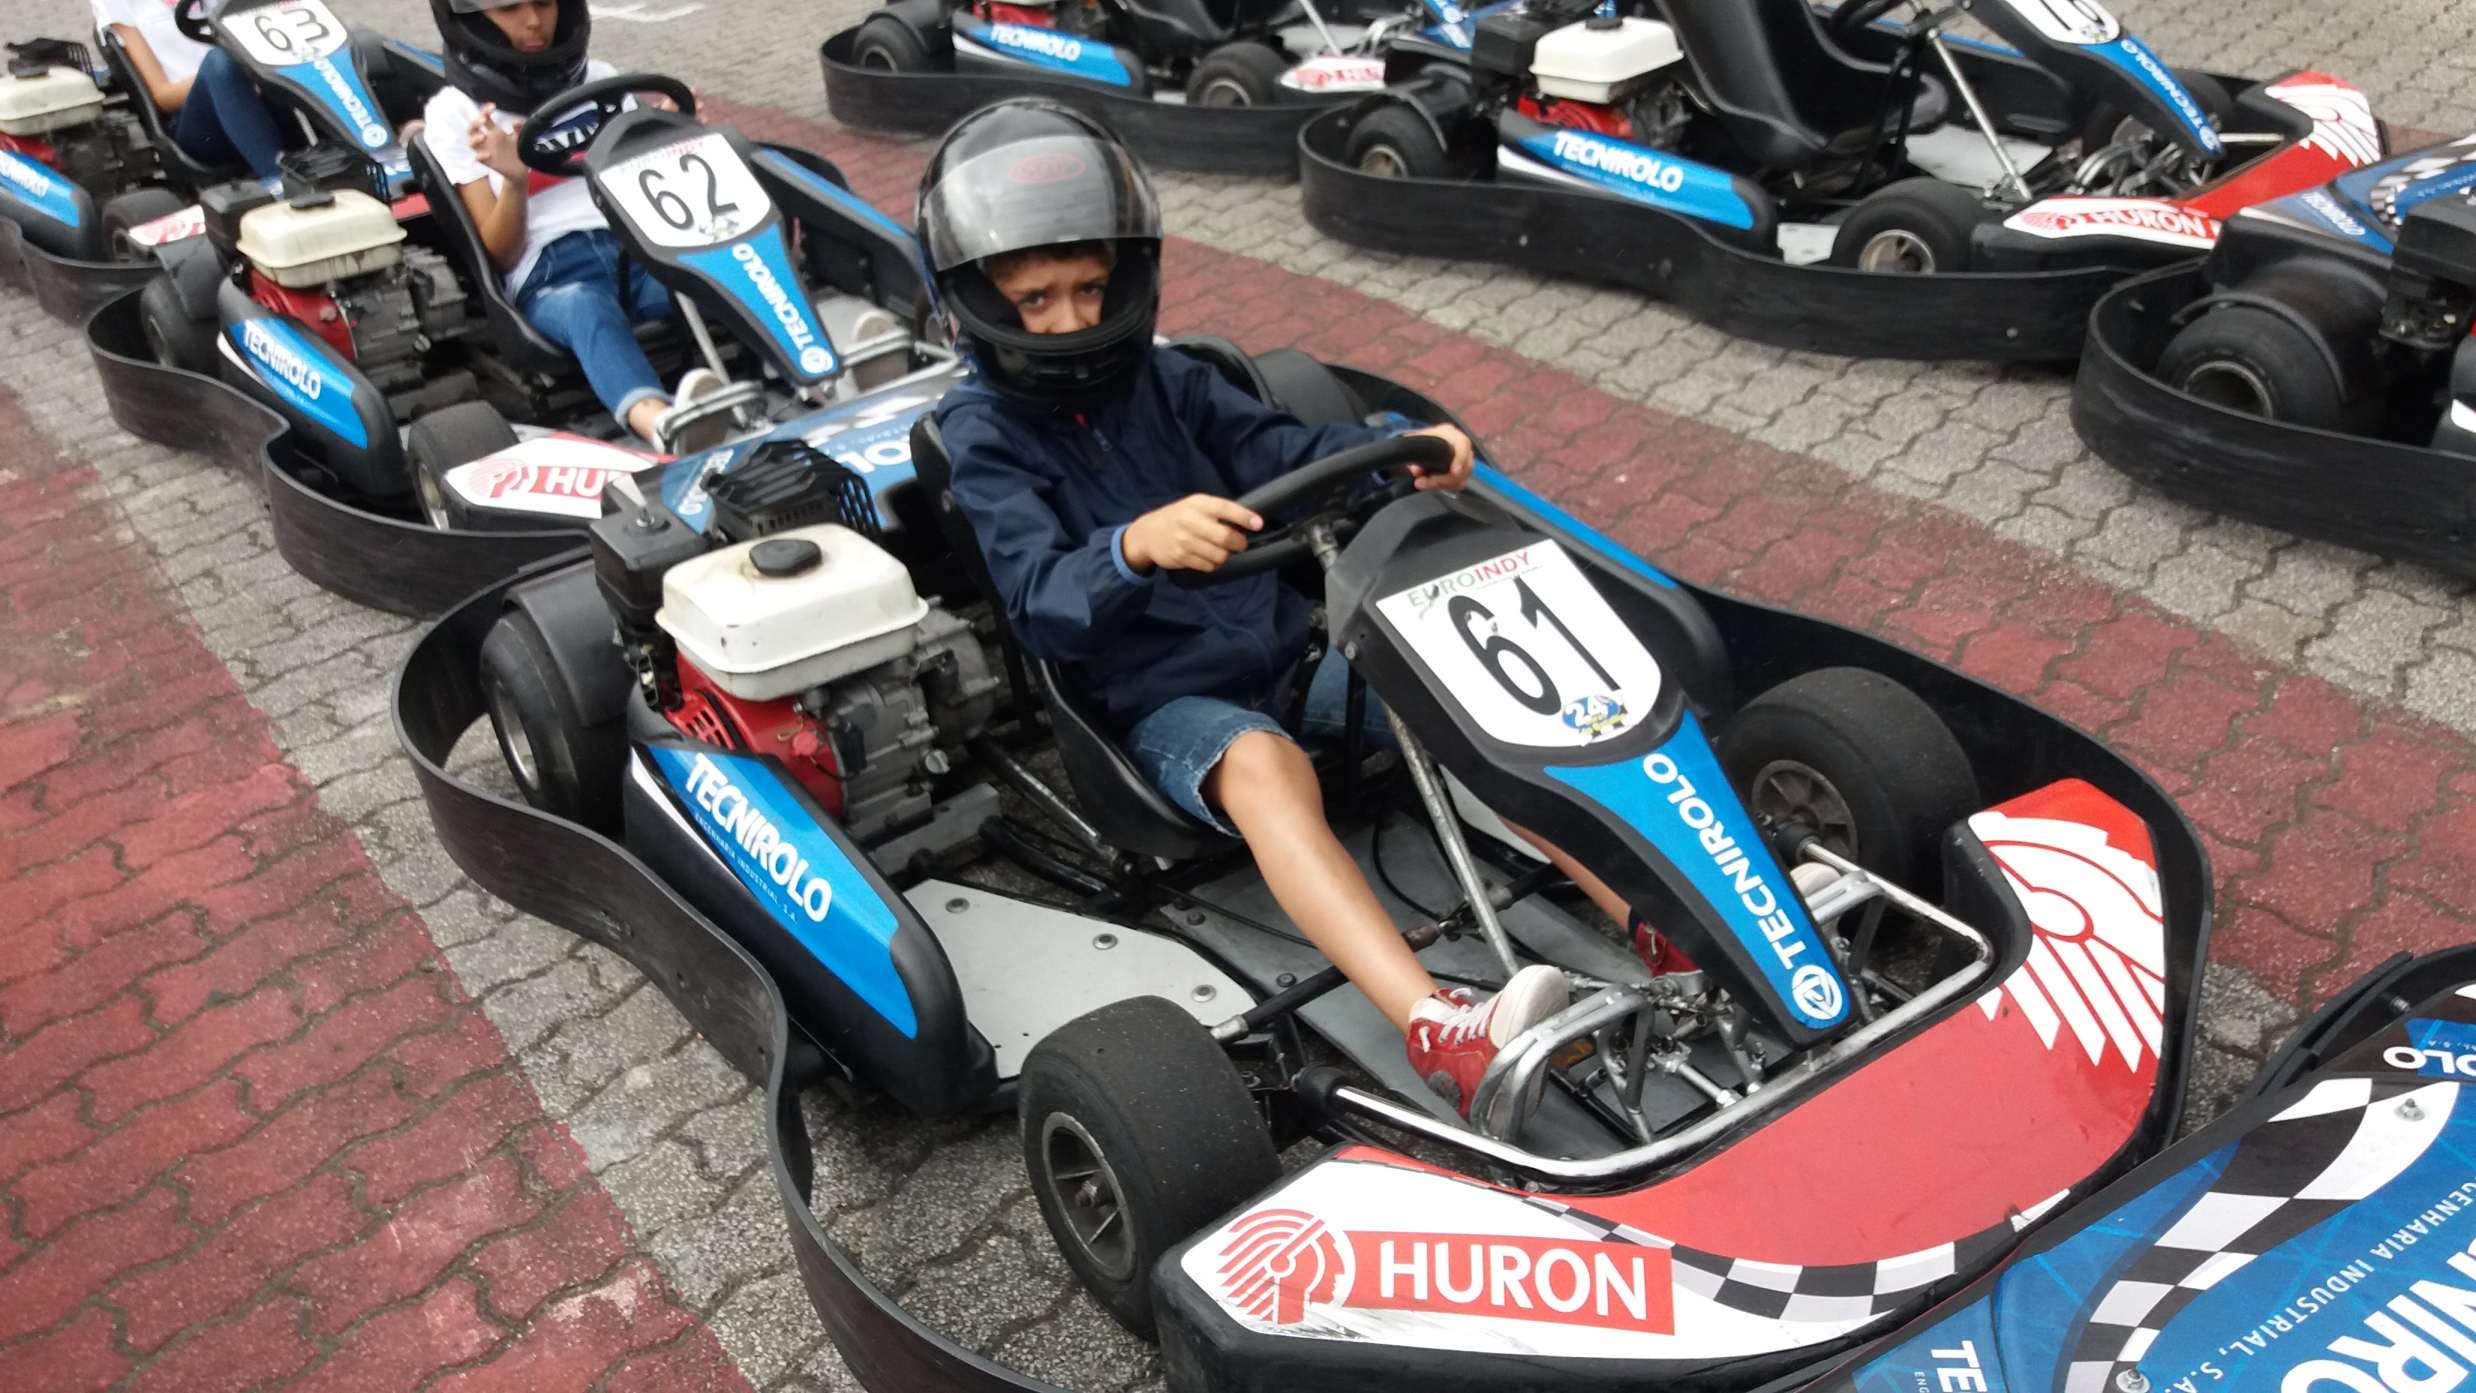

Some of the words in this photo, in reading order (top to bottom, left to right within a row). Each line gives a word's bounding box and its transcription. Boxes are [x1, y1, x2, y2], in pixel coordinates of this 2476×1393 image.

[254, 8, 330, 51] 63
[638, 154, 739, 230] 62
[1554, 130, 1685, 192] TECNIROLO
[2095, 208, 2207, 238] HURON
[732, 243, 815, 350] TECNIROLO
[244, 319, 321, 400] TECNIROLO
[545, 466, 612, 498] HU
[1407, 551, 1531, 608] EUROINDY
[1448, 575, 1621, 716] 61
[686, 753, 832, 922] TECNIROLO
[1643, 753, 1806, 970] TECNIROLO
[1380, 1240, 1646, 1320] HURON
[2219, 1259, 2374, 1356] INDUSTRIAL,
[1931, 1340, 1988, 1392] TE
